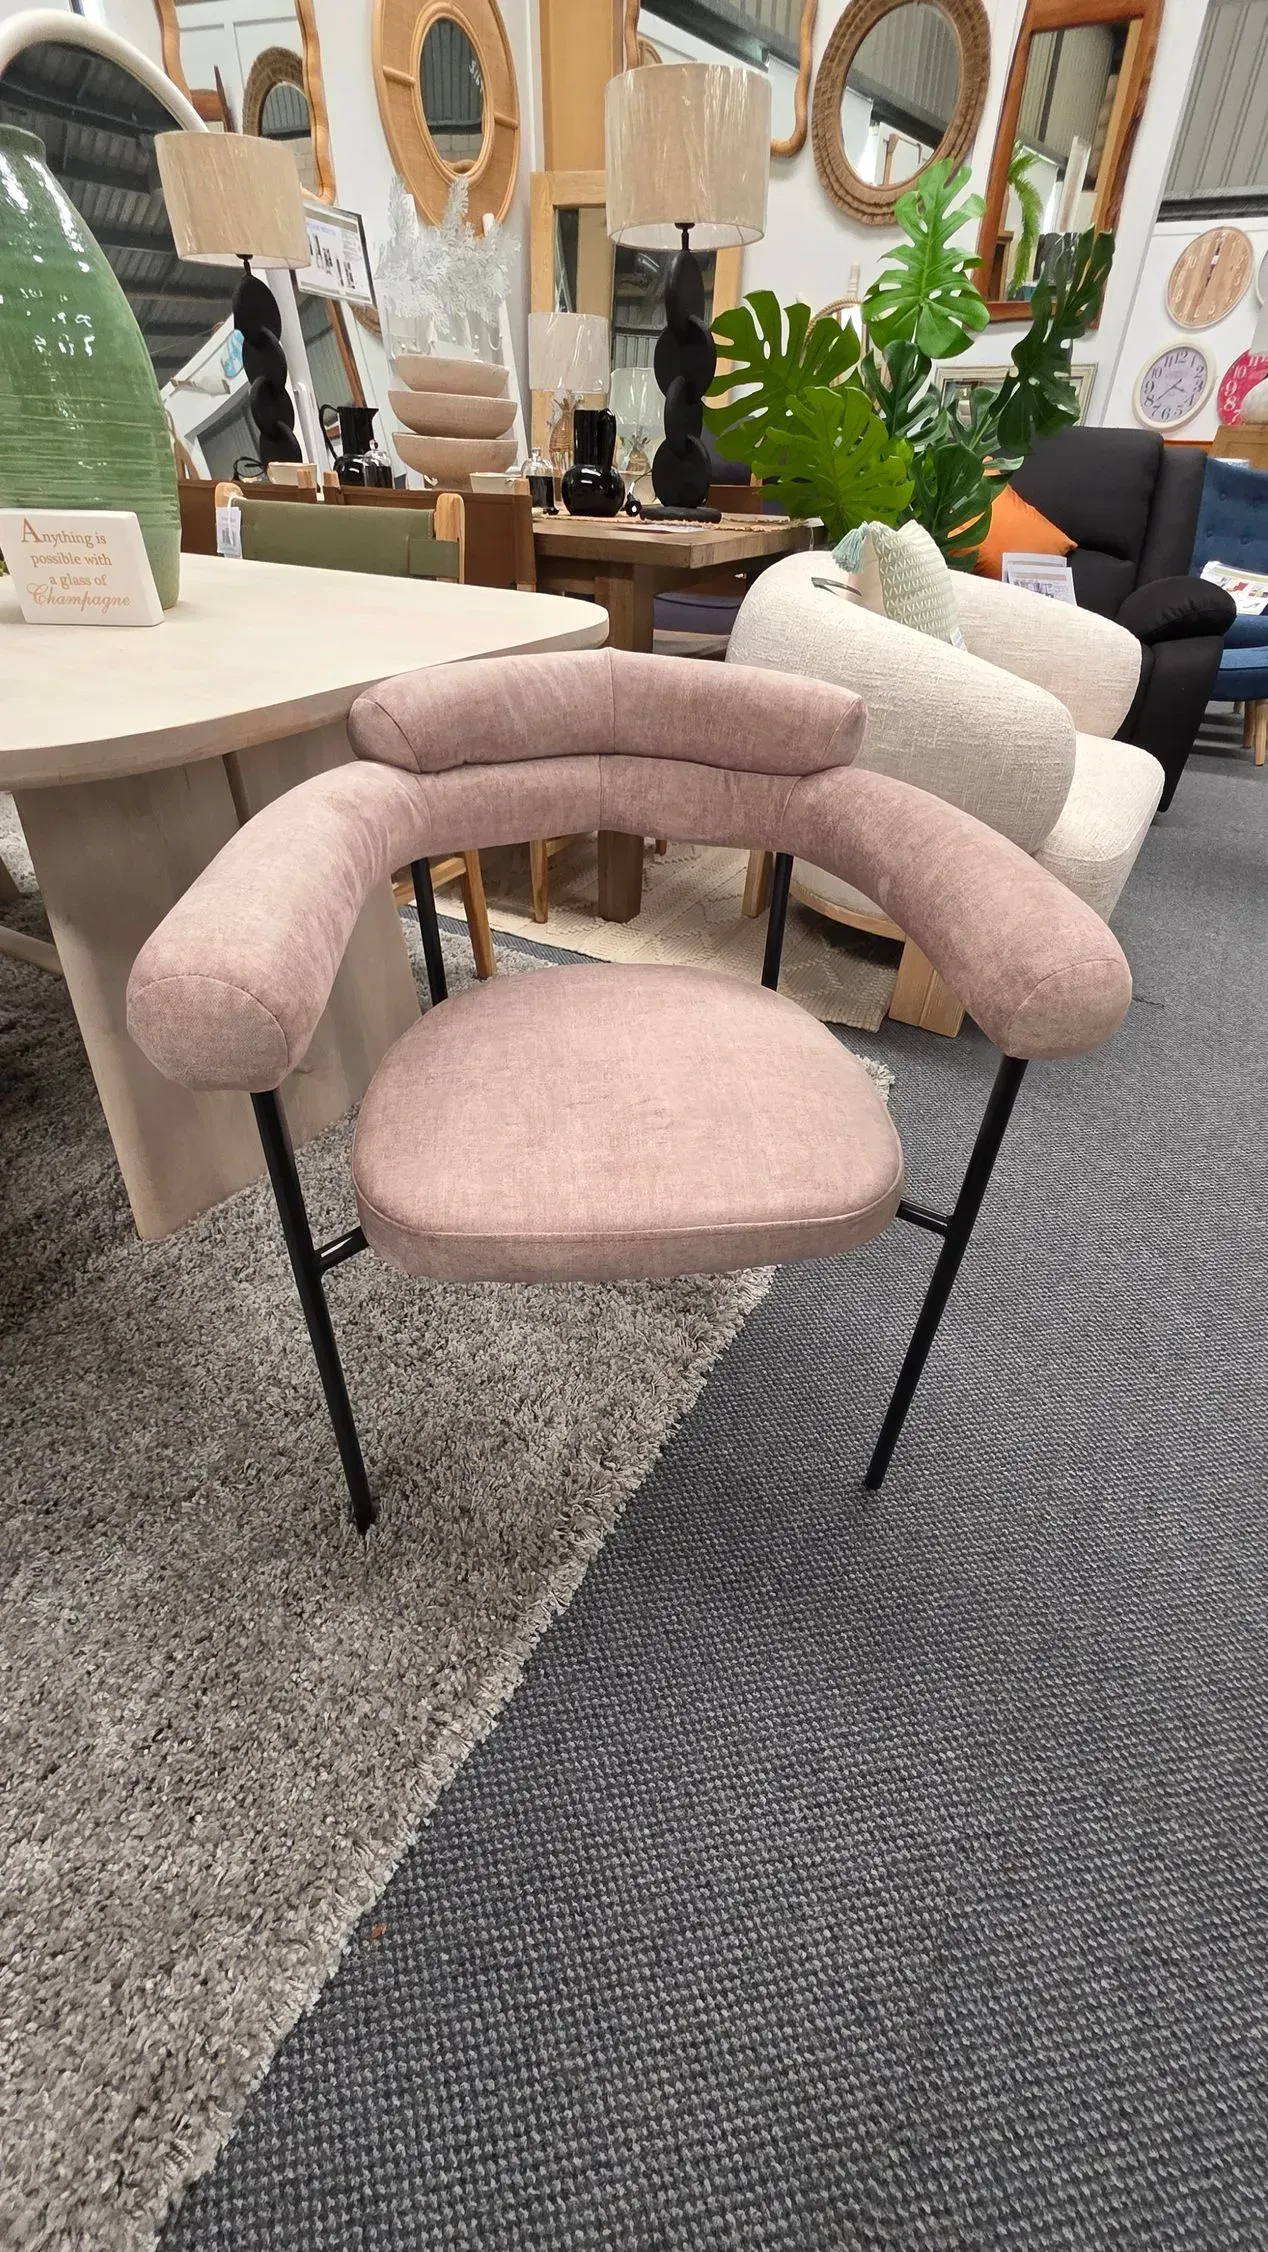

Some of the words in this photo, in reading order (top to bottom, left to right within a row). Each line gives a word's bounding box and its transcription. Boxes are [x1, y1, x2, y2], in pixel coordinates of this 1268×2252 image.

[1164, 356, 1173, 367] 11
[1174, 350, 1188, 364] 12
[1190, 355, 1196, 368] 1
[1249, 355, 1259, 367] 11
[1151, 367, 1163, 379] 10
[1194, 366, 1204, 379] 2
[1233, 364, 1247, 379] 10
[1144, 380, 1155, 394] 9
[1193, 380, 1203, 392] 3
[1225, 380, 1237, 397] 9
[1144, 394, 1154, 407] 8
[1184, 393, 1195, 406] 4
[1224, 396, 1236, 411] 8
[1151, 403, 1161, 417] 7
[1161, 407, 1171, 419] 6
[1174, 405, 1183, 416] 5
[21, 518, 94, 548] Anything
[95, 532, 107, 544] is
[30, 552, 82, 567] possible
[84, 553, 112, 566] with
[50, 576, 58, 585] a
[59, 573, 92, 590] glass
[94, 574, 108, 586] of
[26, 583, 132, 614] Champagne
